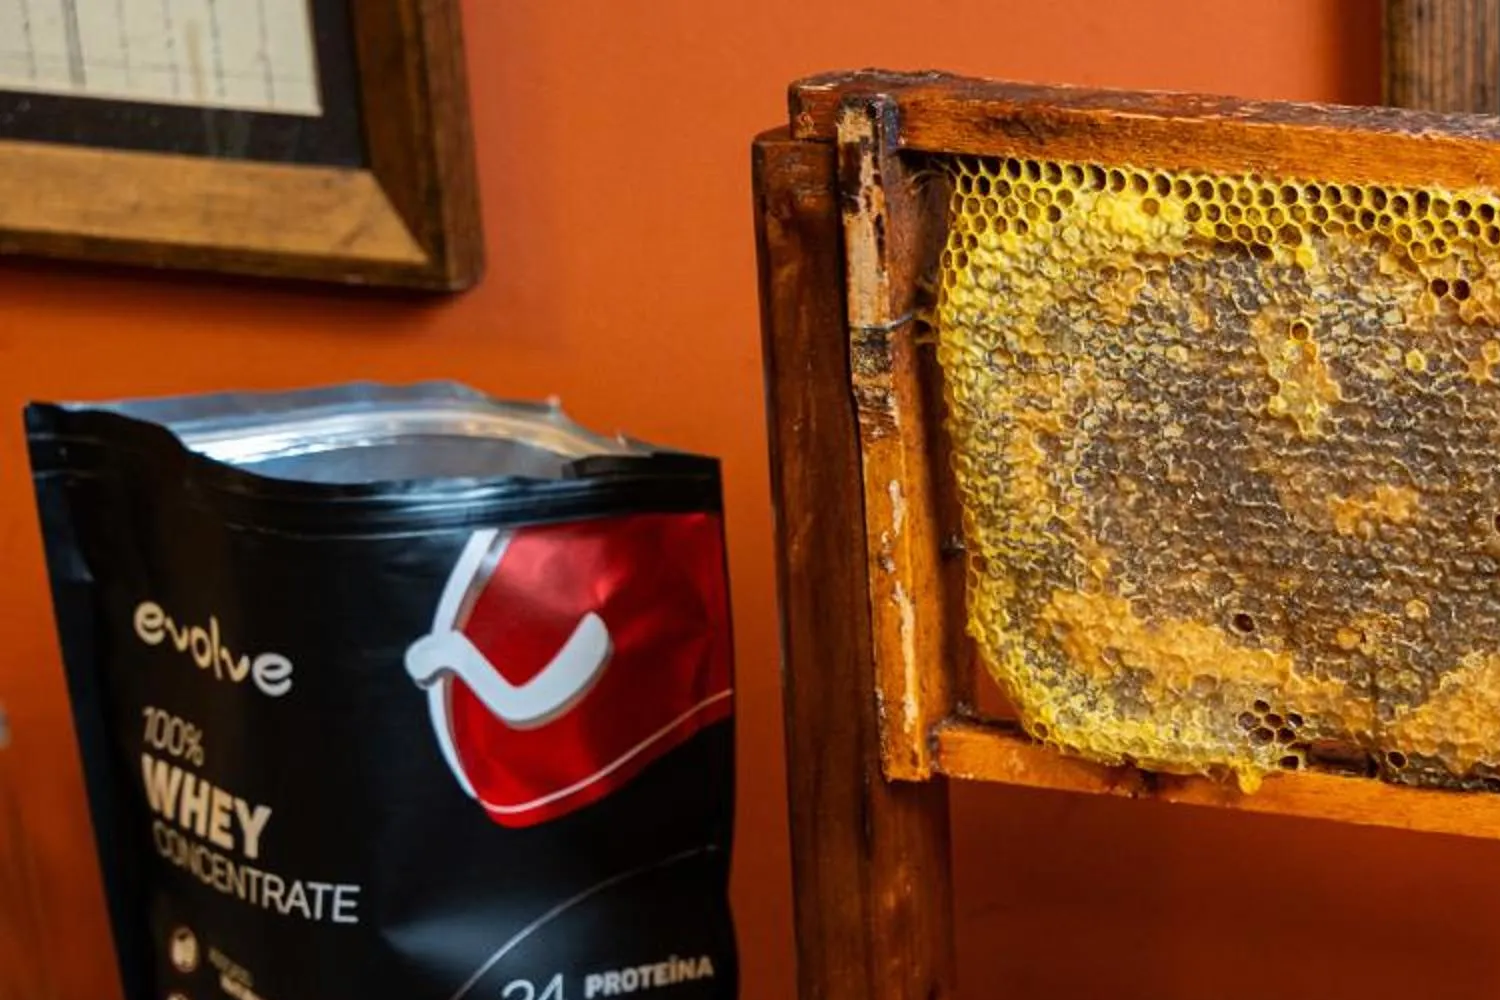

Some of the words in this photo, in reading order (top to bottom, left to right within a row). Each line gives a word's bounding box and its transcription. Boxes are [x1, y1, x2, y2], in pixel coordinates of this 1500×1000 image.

[134, 601, 294, 697] evolve
[142, 706, 205, 768] 100%
[141, 752, 273, 860] WHEY
[153, 819, 361, 925] CONCENTRATE
[584, 954, 715, 1000] PROTEÍNA
